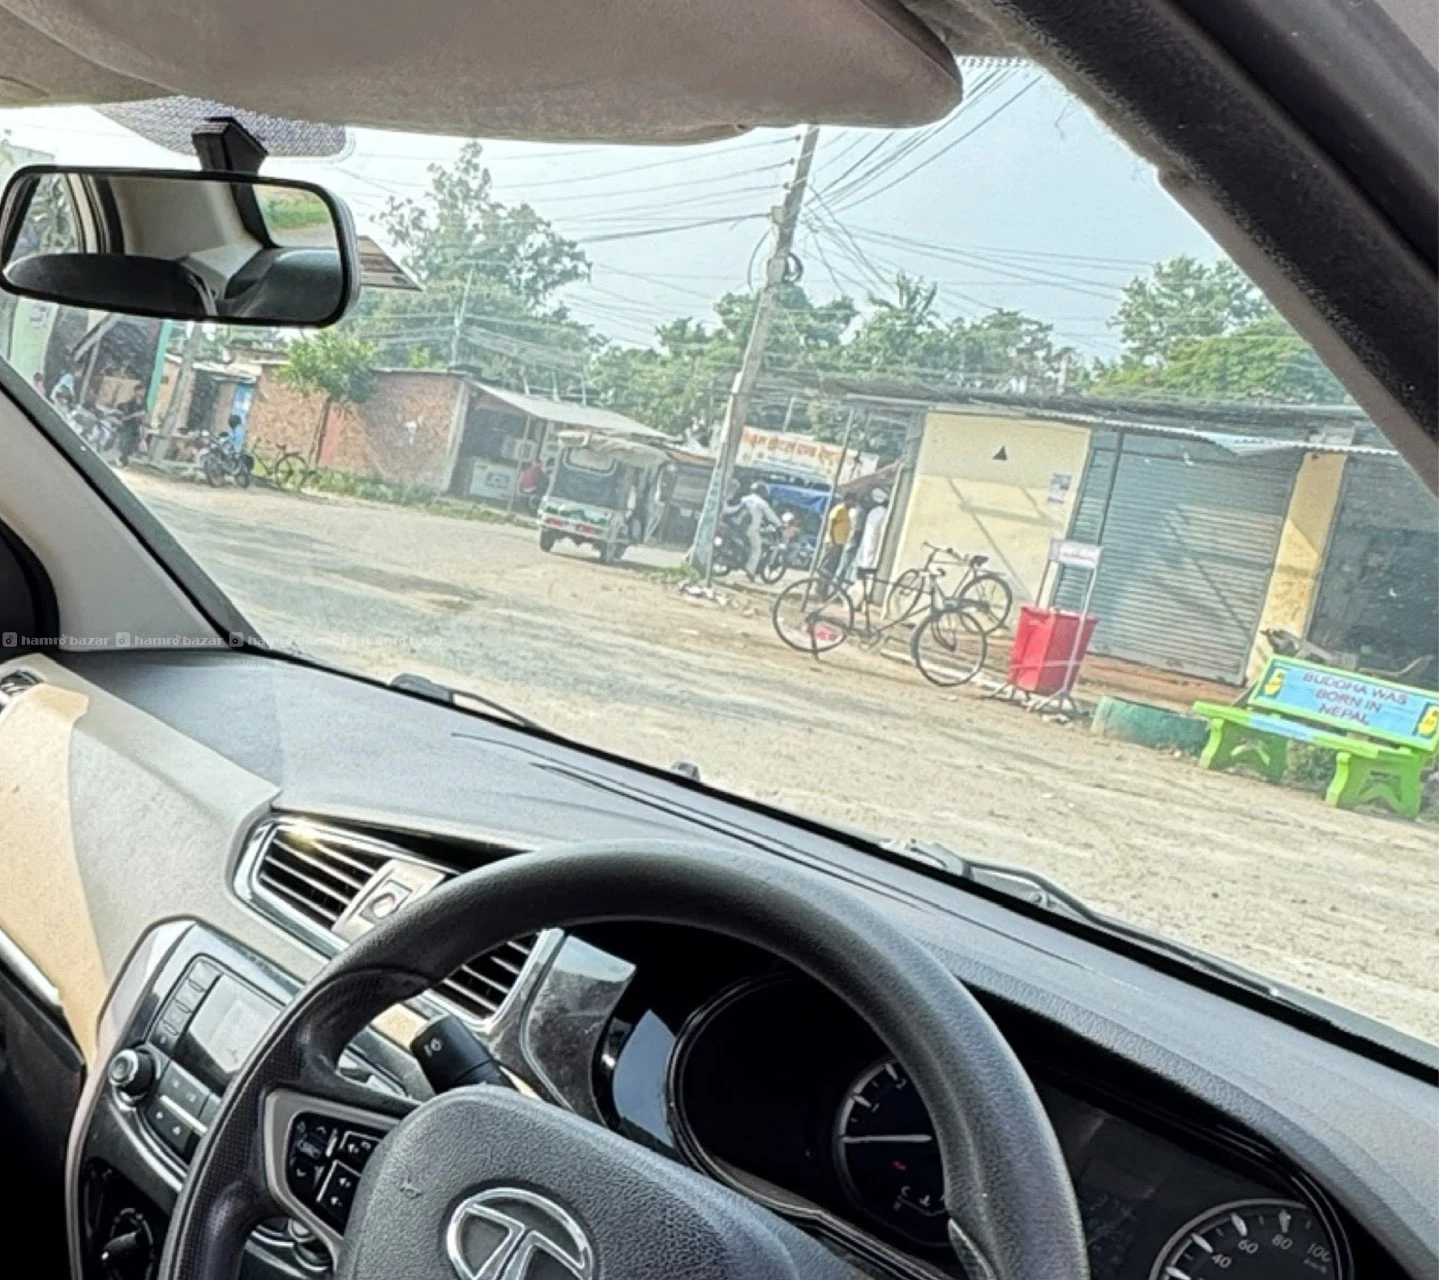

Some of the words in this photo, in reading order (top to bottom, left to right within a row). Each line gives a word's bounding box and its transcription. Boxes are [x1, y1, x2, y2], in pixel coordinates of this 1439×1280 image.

[1303, 671, 1368, 695] BUDDHA
[1372, 687, 1409, 706] WAS
[1315, 689, 1361, 708] BORN
[1366, 700, 1383, 713] IN
[1318, 703, 1370, 726] NEPAL
[1237, 1239, 1259, 1255] 60
[1271, 1233, 1293, 1251] 80
[1211, 1253, 1233, 1269] 40
